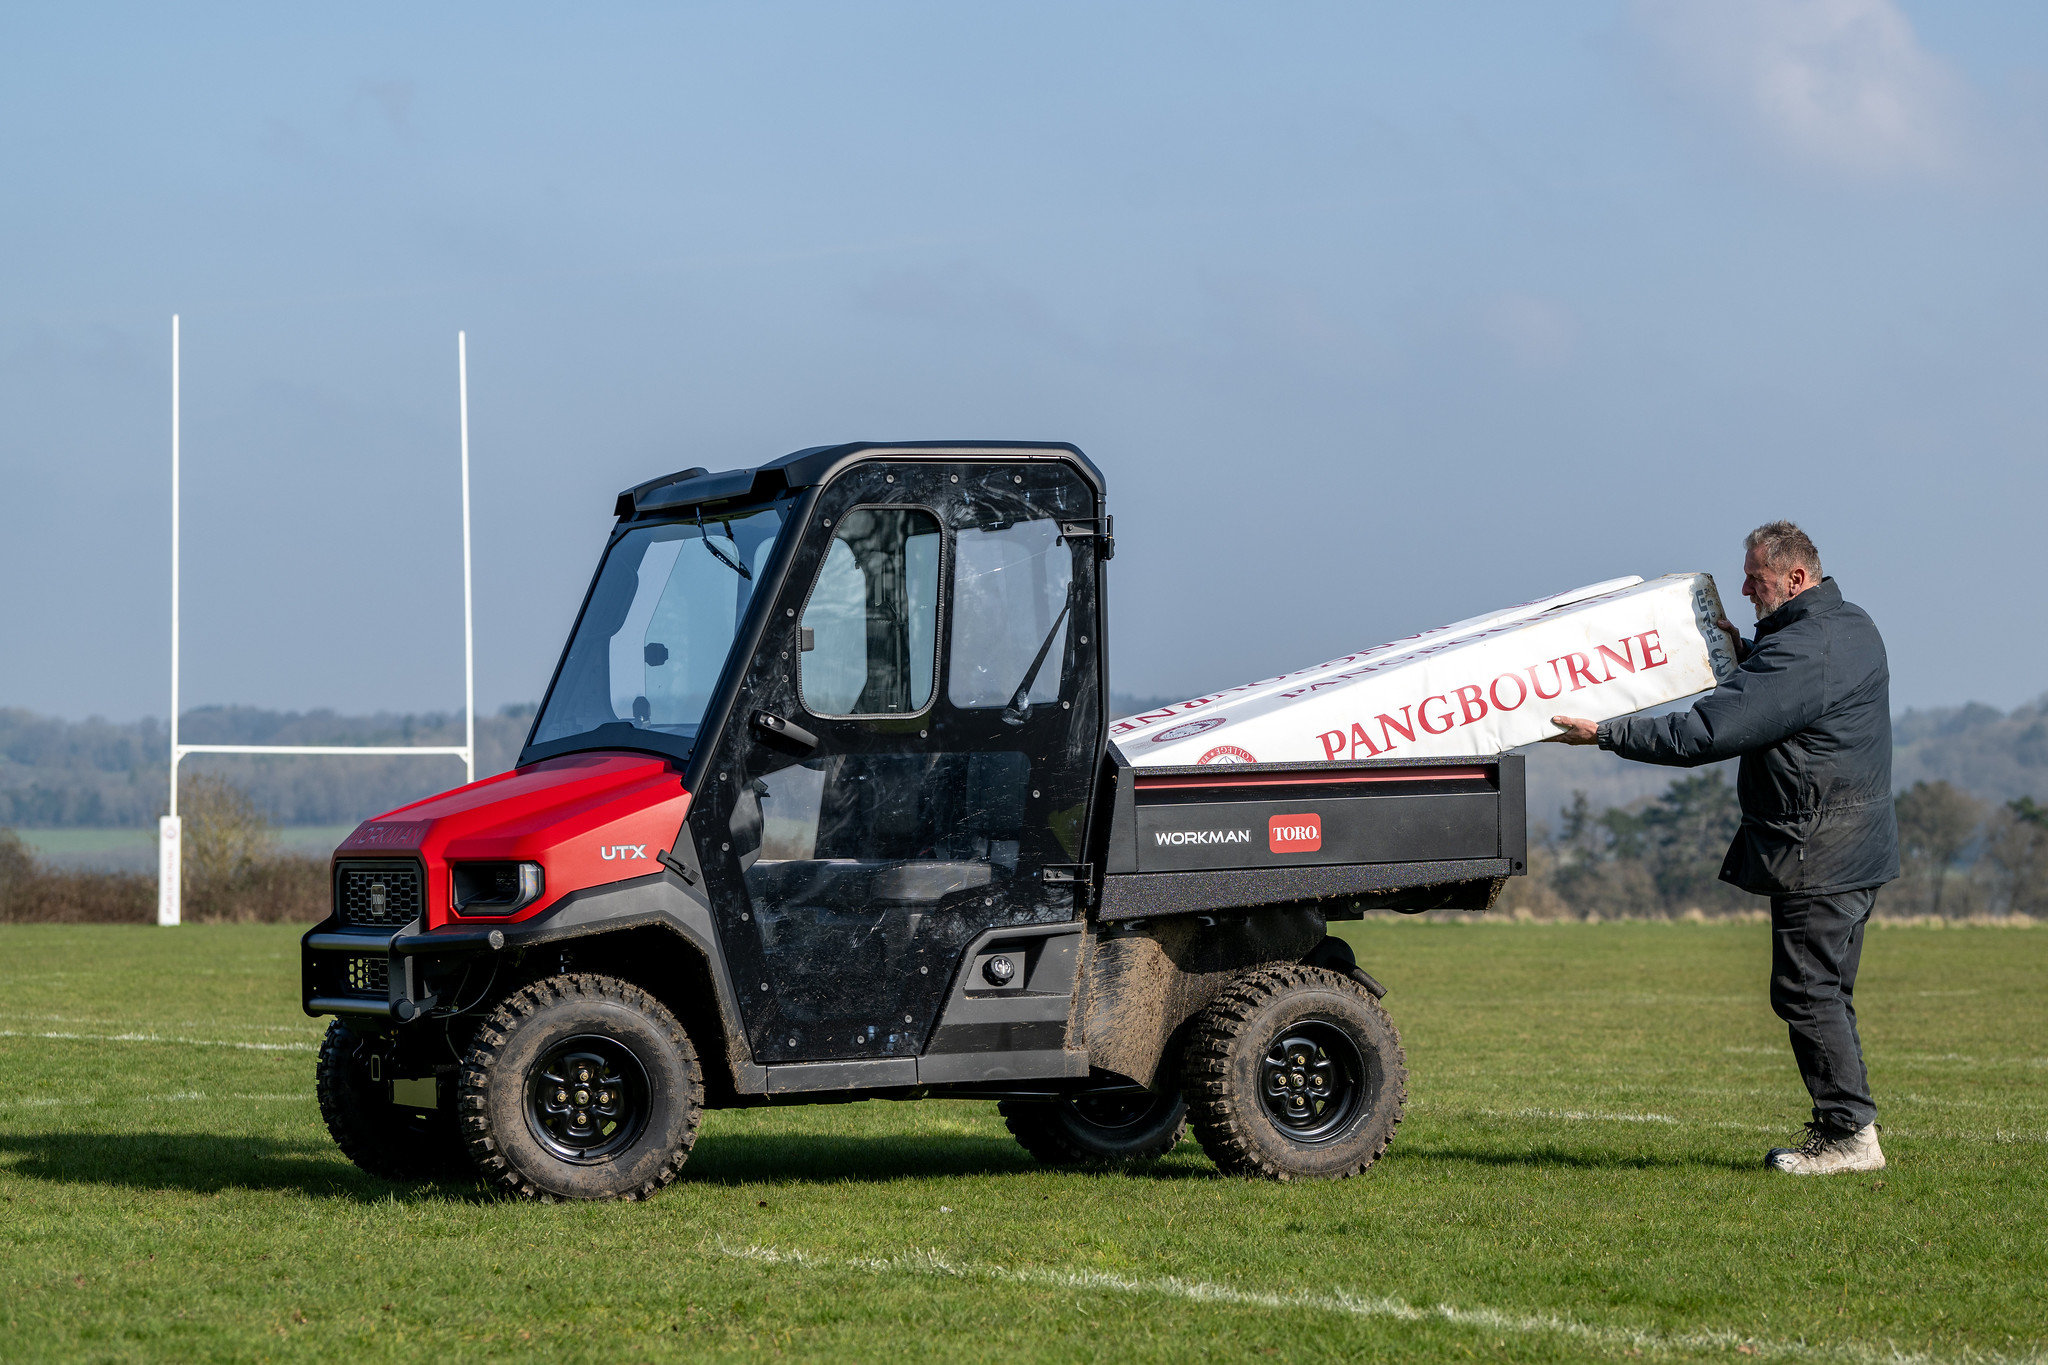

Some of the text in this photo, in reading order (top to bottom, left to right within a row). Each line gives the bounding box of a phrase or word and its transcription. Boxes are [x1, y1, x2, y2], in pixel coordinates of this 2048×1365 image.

[1316, 629, 1668, 761] PANGBOURNE
[1214, 746, 1254, 763] COLLEGE
[1155, 830, 1250, 845] WORKMAN
[1273, 825, 1318, 841] TORO
[601, 844, 648, 860] UTX
